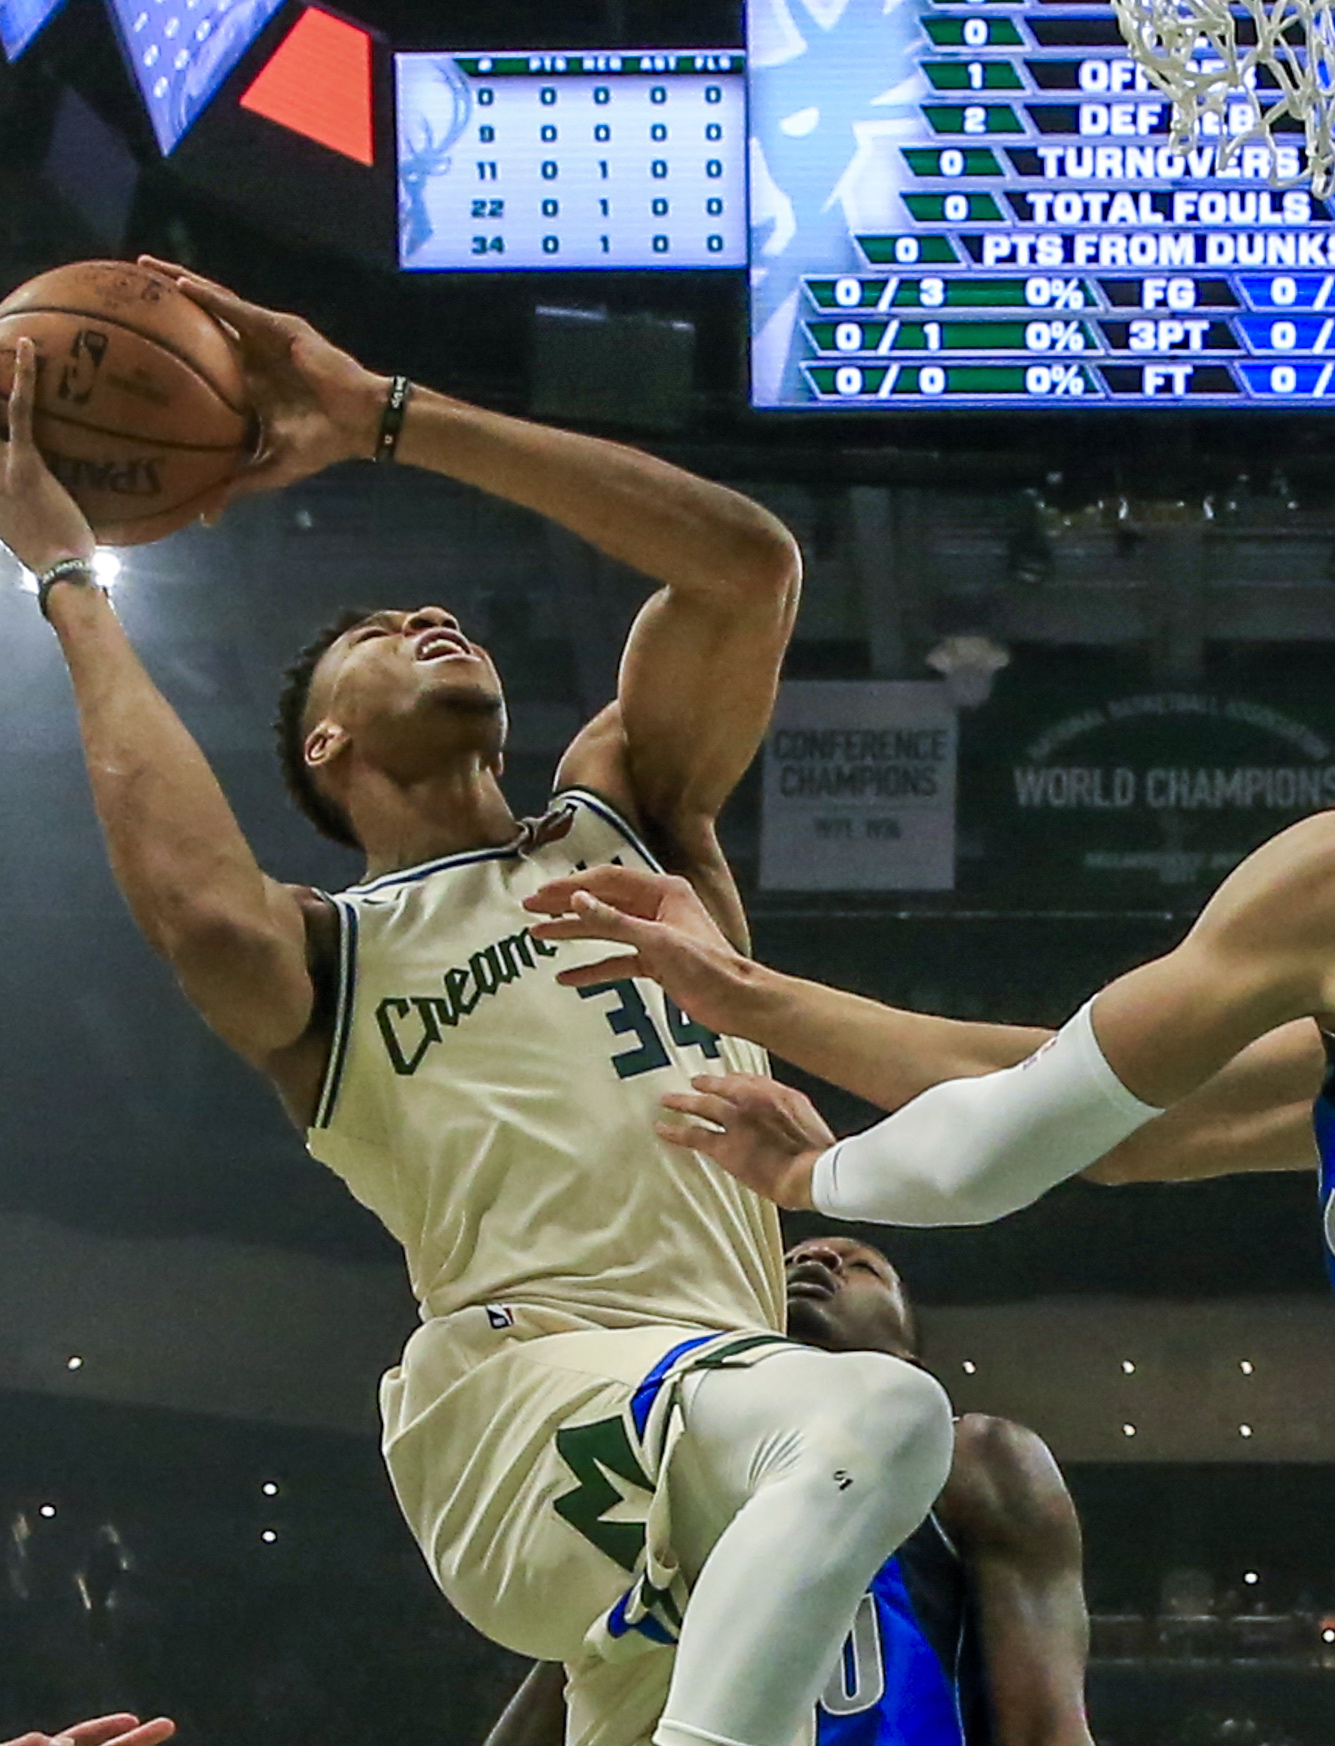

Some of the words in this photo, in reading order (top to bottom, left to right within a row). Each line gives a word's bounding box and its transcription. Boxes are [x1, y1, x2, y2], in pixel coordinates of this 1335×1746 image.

[964, 19, 988, 47] 0
[968, 62, 983, 89] 1
[477, 87, 494, 106] 0
[539, 86, 558, 106] 0
[593, 85, 611, 105] 0
[649, 85, 667, 105] 0
[704, 84, 722, 104] 0
[540, 124, 558, 143] 0
[593, 123, 611, 142] 0
[650, 123, 668, 142] 0
[705, 123, 722, 141] 0
[964, 106, 986, 133] 2
[1076, 102, 1165, 139] DEF
[476, 161, 497, 181] 11
[541, 160, 559, 180] 0
[598, 160, 608, 179] 1
[650, 159, 668, 179] 0
[705, 159, 723, 179] 0
[940, 149, 963, 176] 0
[1037, 147, 1300, 178] TURNOVERS
[470, 199, 505, 218] 22
[541, 198, 559, 218] 0
[599, 198, 609, 217] 1
[651, 197, 669, 217] 0
[706, 197, 724, 216] 0
[945, 195, 968, 221] 0
[1024, 192, 1170, 225] TOTAL
[1172, 192, 1314, 225] FOULS
[471, 235, 505, 255] 34
[541, 235, 560, 255] 0
[599, 234, 610, 254] 1
[652, 234, 670, 254] 0
[706, 234, 724, 253] 0
[895, 237, 919, 263] 0
[979, 233, 1066, 268] PTS
[1070, 233, 1198, 268] FROM
[835, 277, 861, 306] 0
[920, 277, 944, 306] 3
[1021, 277, 1088, 310] 0%
[1140, 277, 1201, 313] FG
[1270, 276, 1297, 305] 0
[836, 323, 861, 353] 0
[923, 324, 941, 351] 1
[1021, 321, 1088, 354] 0%
[1124, 320, 1213, 355] 3PT
[1270, 324, 1296, 351] 0
[836, 366, 862, 396] 0
[919, 366, 945, 394] 0
[1026, 365, 1088, 398] 0%
[1144, 363, 1198, 400] FT
[1270, 365, 1297, 393] 0
[1016, 766, 1135, 806] WORLD
[575, 976, 721, 1080] 34
